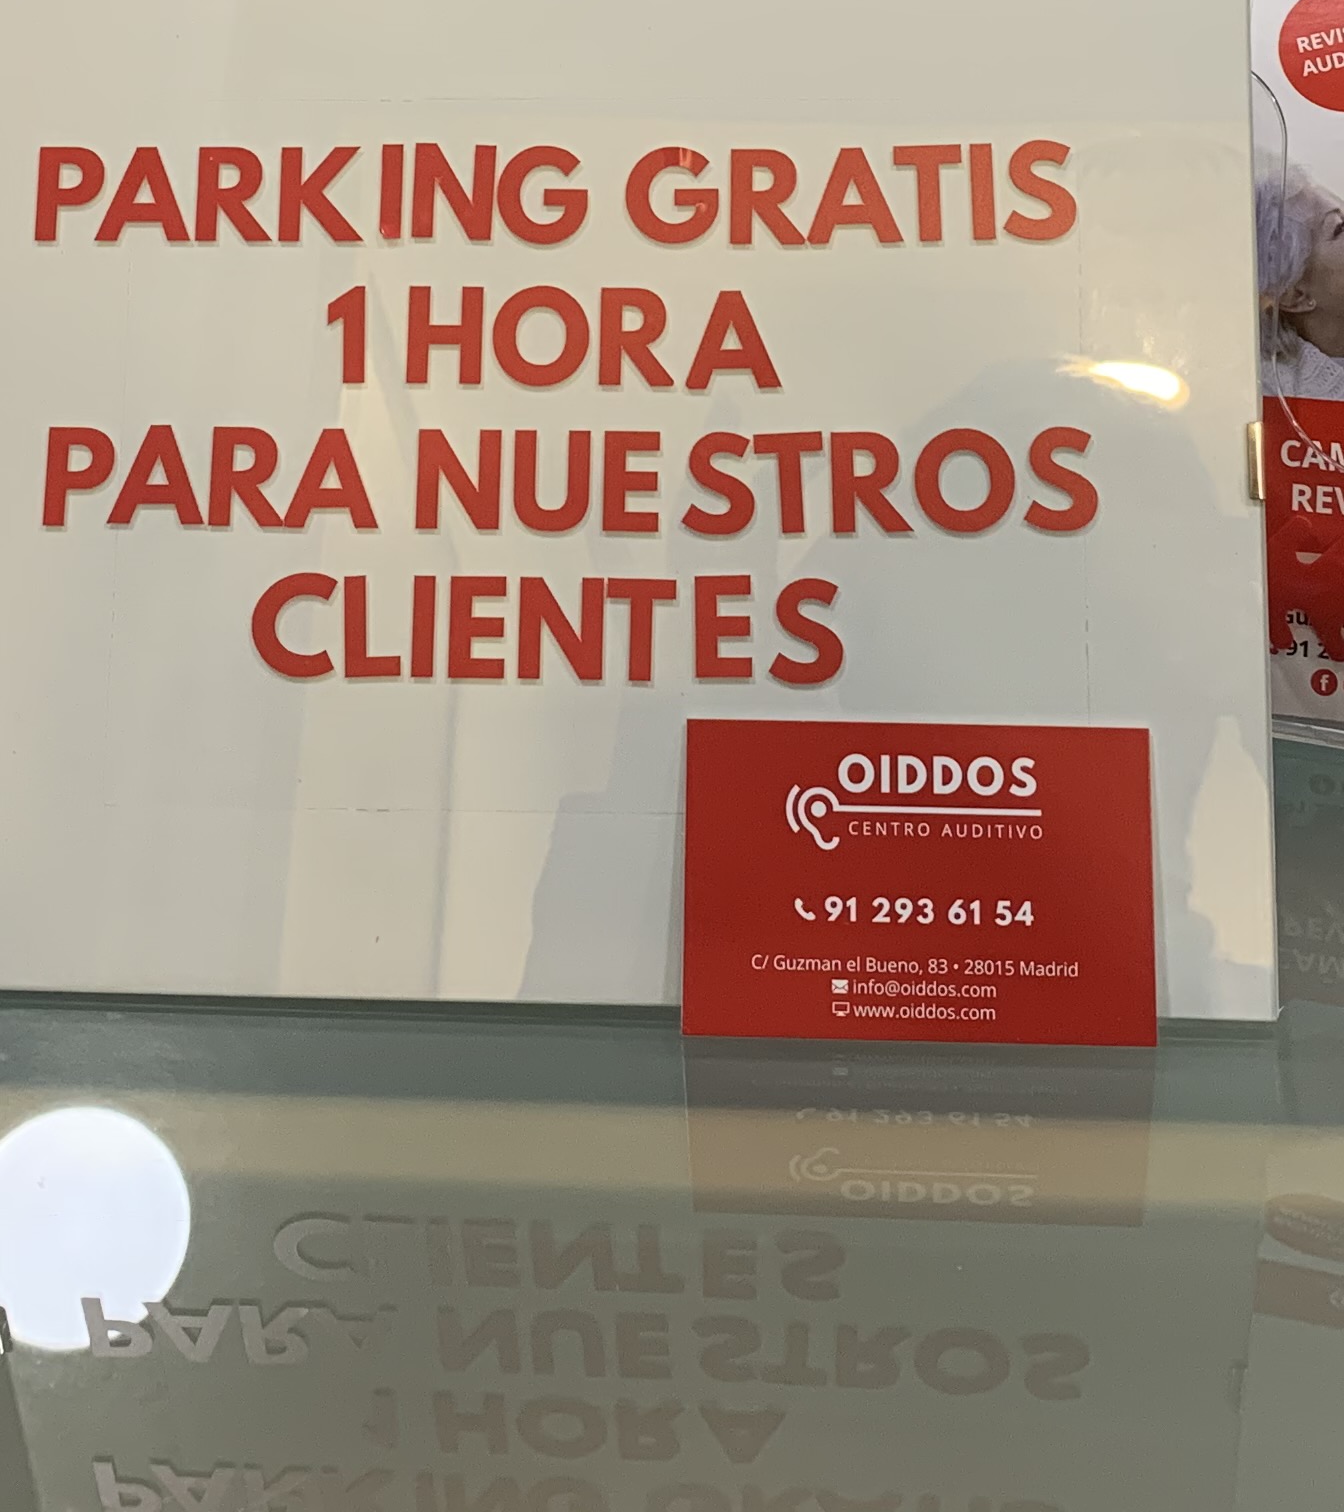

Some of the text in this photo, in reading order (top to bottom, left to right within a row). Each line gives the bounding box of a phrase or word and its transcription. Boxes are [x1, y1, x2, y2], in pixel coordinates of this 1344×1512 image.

[35, 141, 1076, 244] PARKING GRATIS
[328, 286, 780, 389] 1 HORA
[43, 425, 1097, 534] PARA NUESTROS
[252, 573, 843, 684] CLIENTES
[838, 753, 1037, 797] OIDDOS
[848, 821, 1044, 840] CENTRO AUDITIVO
[824, 896, 1034, 926] 91 293 61 54
[751, 954, 1079, 977] C/ Guzman el Bueno, 83 28015 Madrid
[853, 978, 997, 999] info@oiddos.com
[853, 1002, 996, 1021] www.oiddos.com
